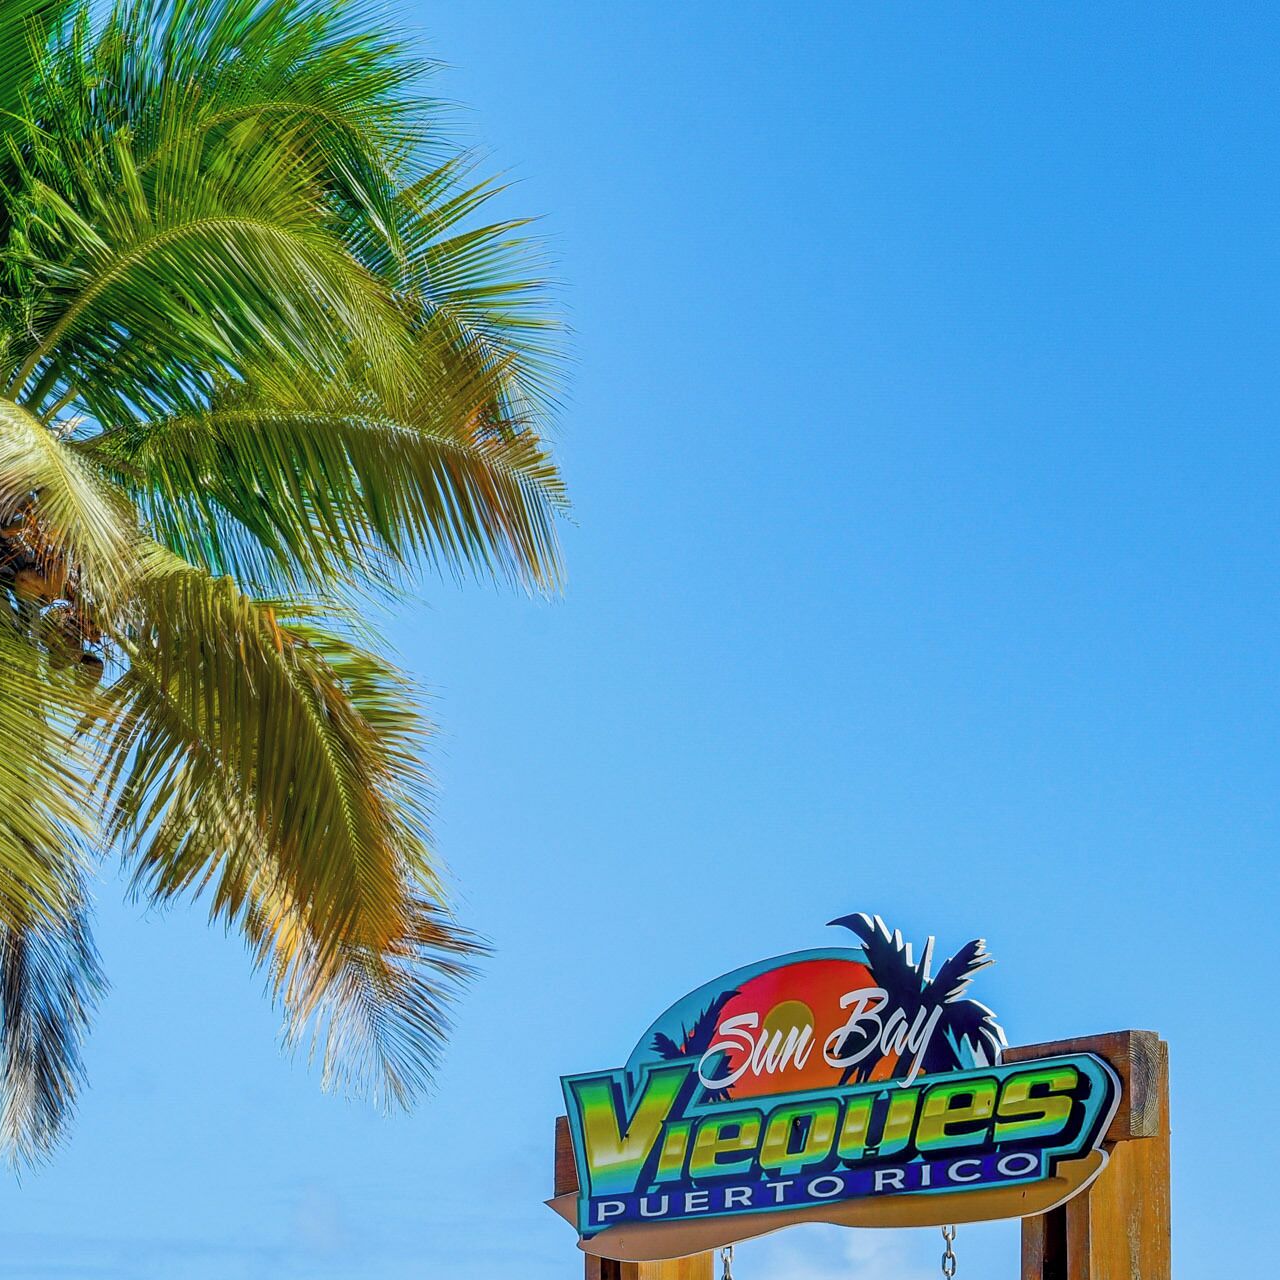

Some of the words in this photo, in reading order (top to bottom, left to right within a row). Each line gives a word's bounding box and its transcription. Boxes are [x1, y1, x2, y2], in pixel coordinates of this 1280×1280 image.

[698, 1011, 815, 1089] Sun
[824, 988, 943, 1087] Bay
[597, 1175, 845, 1222] PUERTO
[874, 1152, 1038, 1191] RICO
